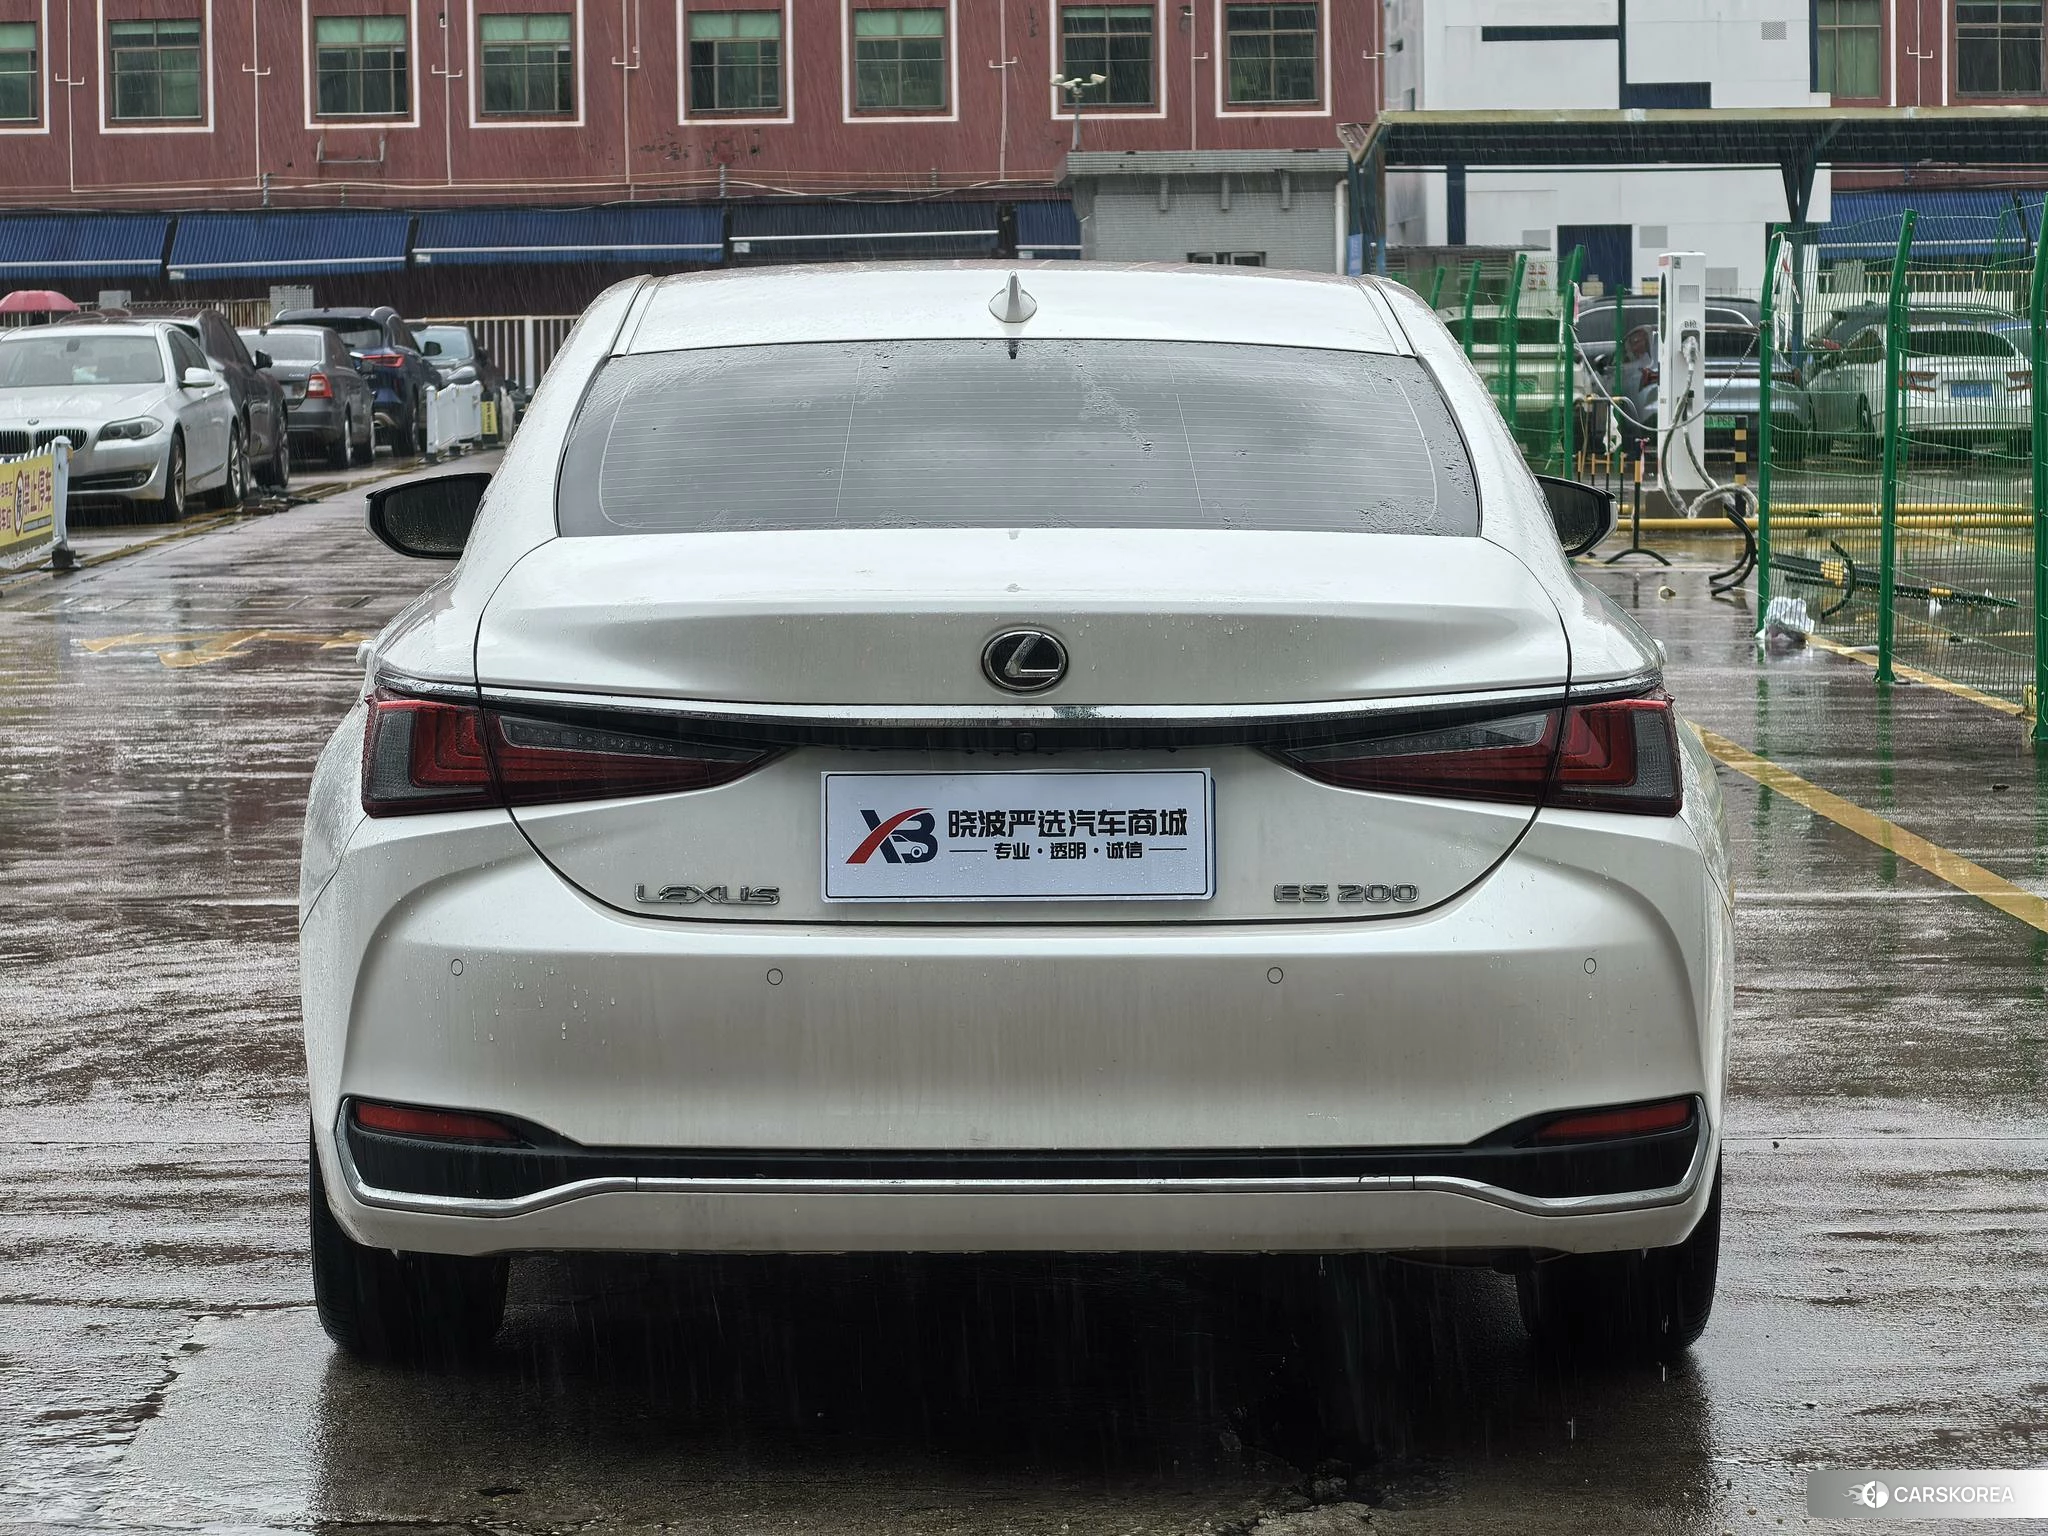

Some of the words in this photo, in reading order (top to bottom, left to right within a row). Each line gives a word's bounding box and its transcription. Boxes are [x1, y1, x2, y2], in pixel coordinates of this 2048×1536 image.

[23, 466, 52, 515] 禁止停车
[948, 808, 1188, 838] 晓波严选汽车商城
[634, 883, 781, 906] LEXUS
[1274, 883, 1330, 903] ES
[1337, 883, 1419, 903] 200
